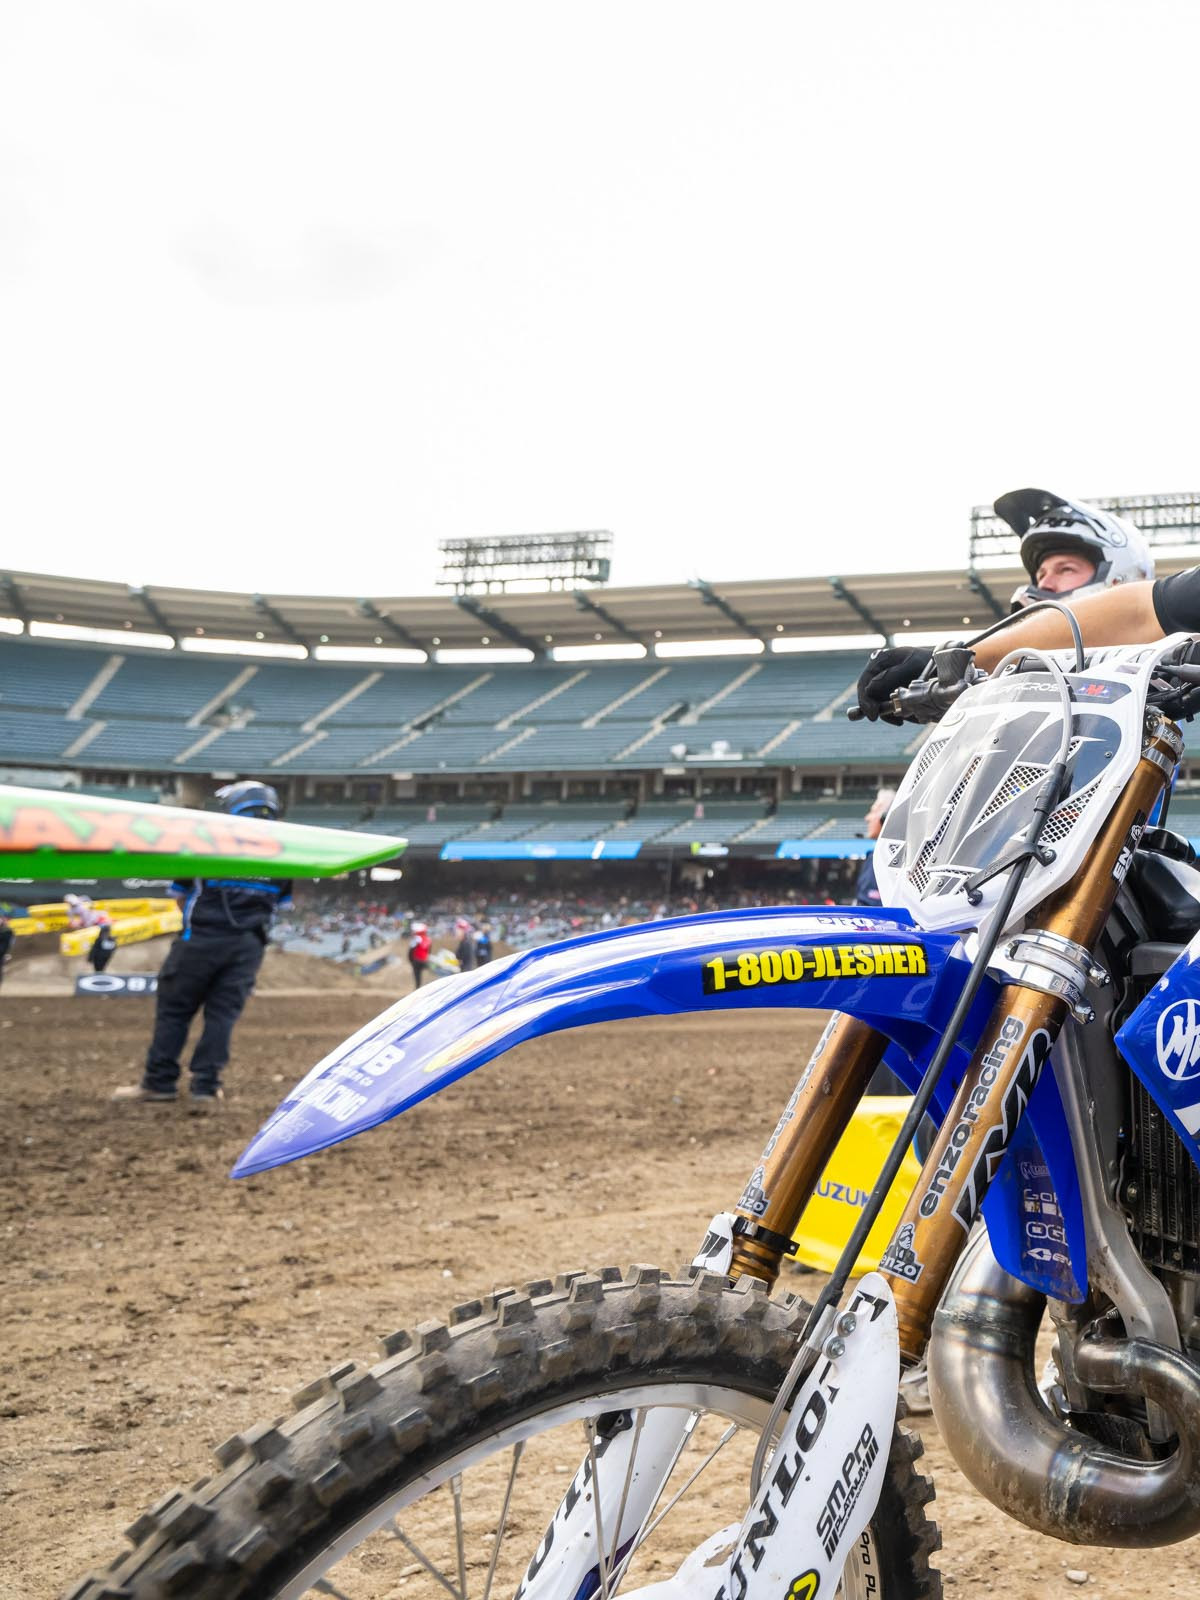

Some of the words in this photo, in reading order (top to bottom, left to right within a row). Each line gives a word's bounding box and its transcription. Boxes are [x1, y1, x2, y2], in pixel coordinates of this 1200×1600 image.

[706, 943, 927, 991] 1-800-JLESHER
[737, 1196, 766, 1212] nzo
[815, 1179, 882, 1213] UZUK
[881, 1252, 918, 1278] enzo
[714, 1360, 842, 1600] UNLO
[834, 1460, 868, 1532] PLATINUM
